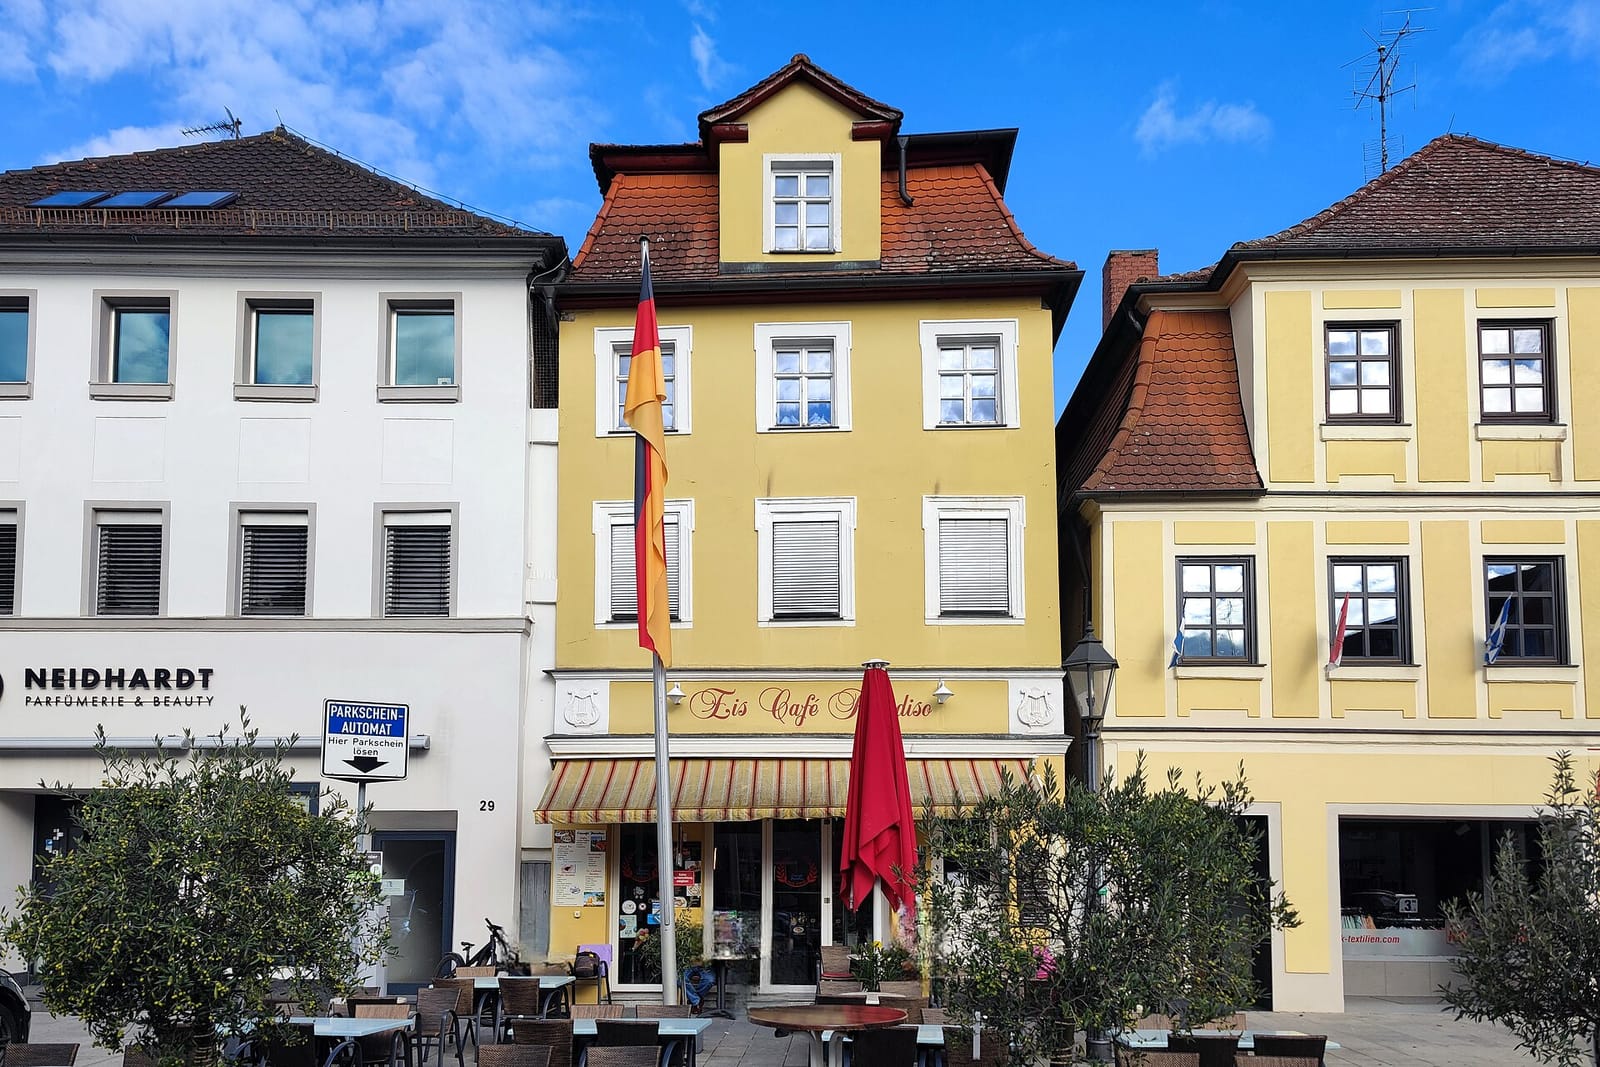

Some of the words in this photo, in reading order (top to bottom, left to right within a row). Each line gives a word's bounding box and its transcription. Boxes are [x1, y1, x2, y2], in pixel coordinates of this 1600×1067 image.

[25, 668, 214, 689] NEIDHARDT
[25, 694, 125, 707] PARFÜMERIE
[134, 696, 144, 707] &
[153, 696, 214, 707] BEAUTY
[689, 687, 748, 720] Eis
[758, 687, 820, 727] Café
[828, 687, 933, 720] Pdiso
[330, 705, 404, 721] PARKSCHEIN-
[341, 721, 392, 735] AUTOMAT
[328, 736, 348, 745] Hier
[352, 737, 404, 748] Parkschein
[353, 747, 379, 756] lösen
[479, 800, 495, 811] 29
